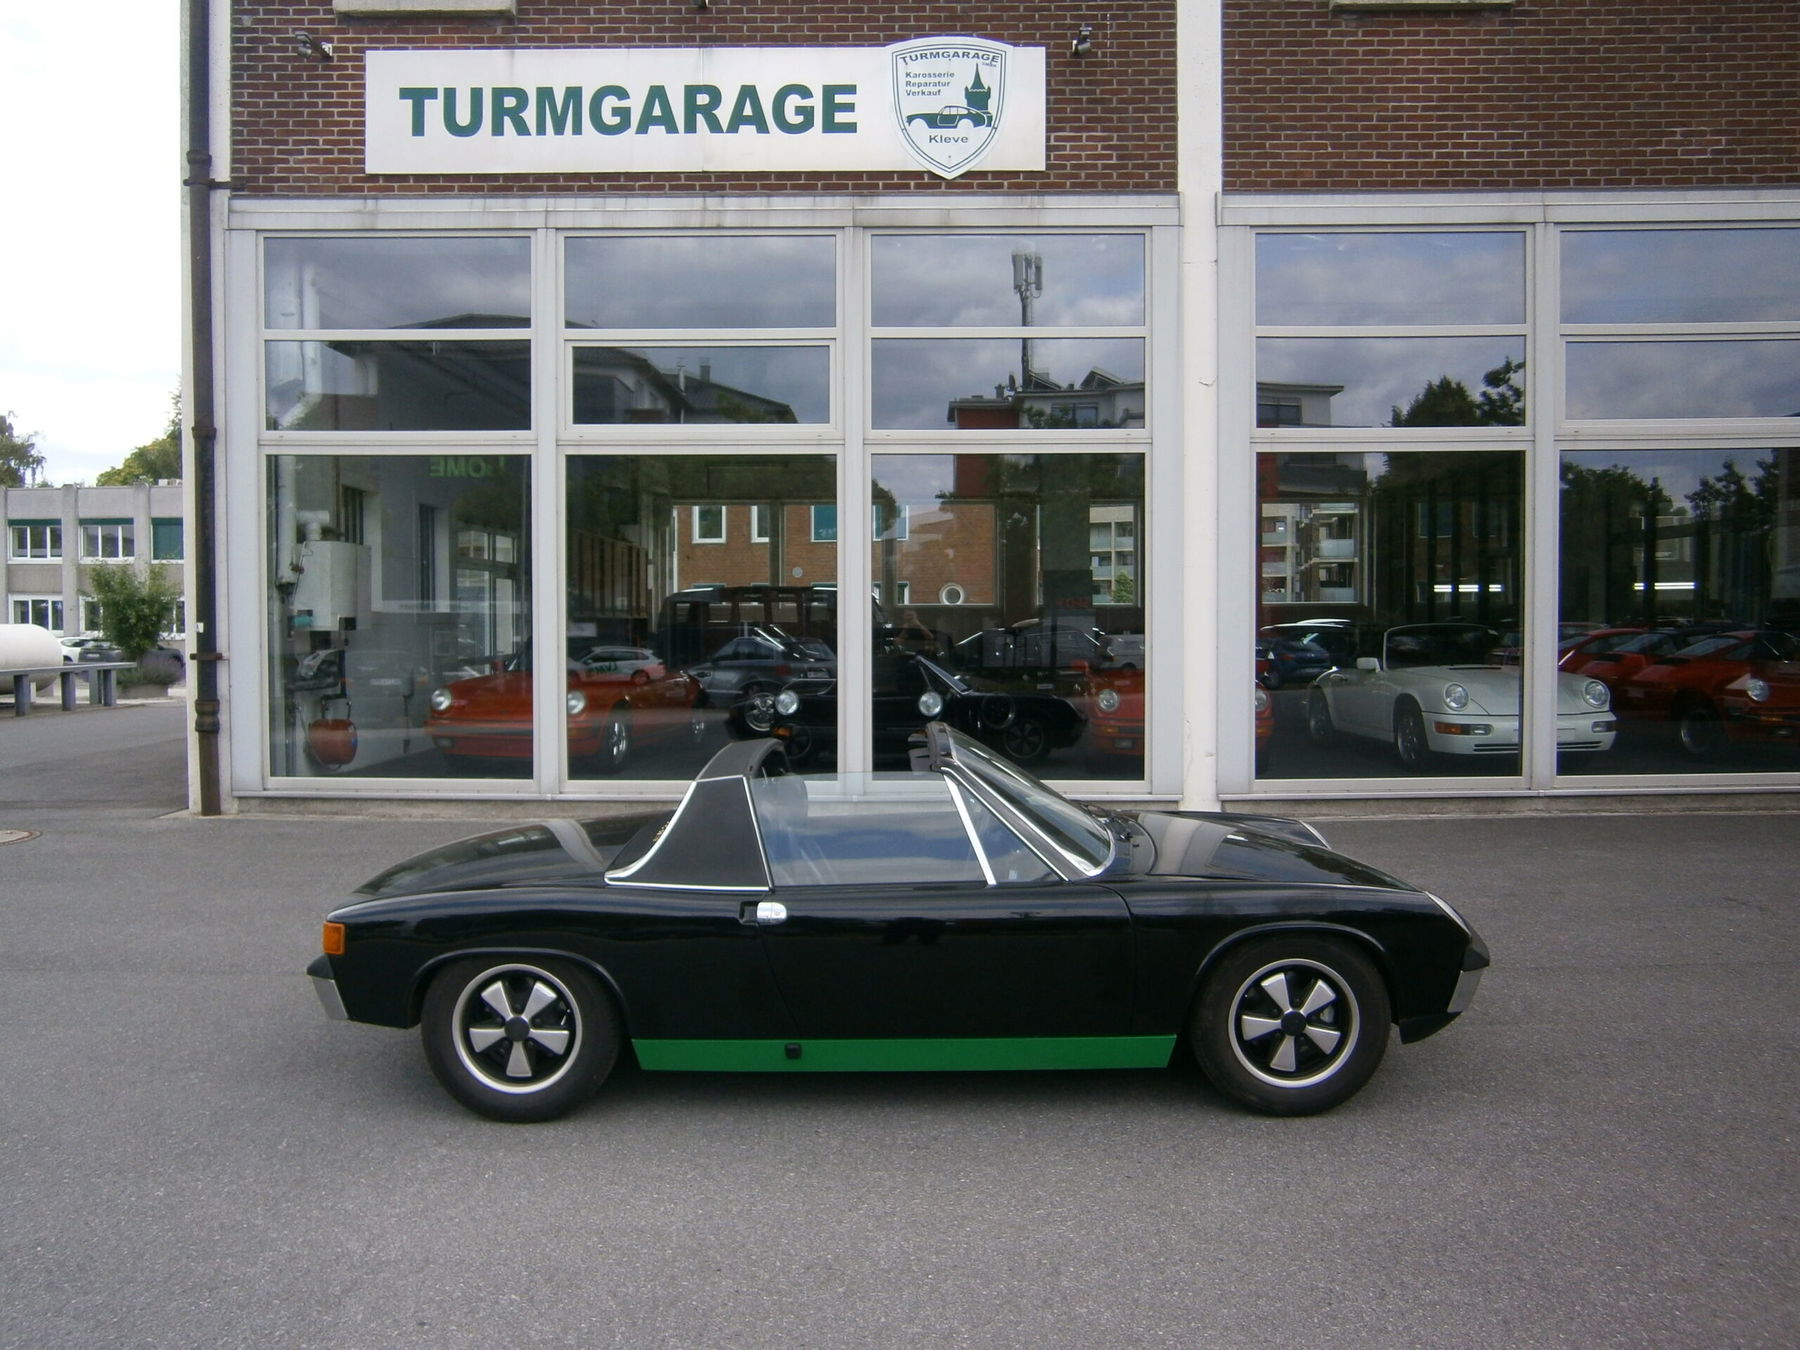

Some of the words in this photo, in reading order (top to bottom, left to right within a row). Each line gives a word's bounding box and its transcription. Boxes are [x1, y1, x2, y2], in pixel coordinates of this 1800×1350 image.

[899, 50, 1000, 66] TURMGARAGE
[905, 71, 955, 79] Karosserie
[905, 80, 951, 88] Reparatur
[905, 89, 941, 97] Verkauf
[400, 84, 858, 137] TURMGARAGE
[928, 135, 969, 144] Kleve
